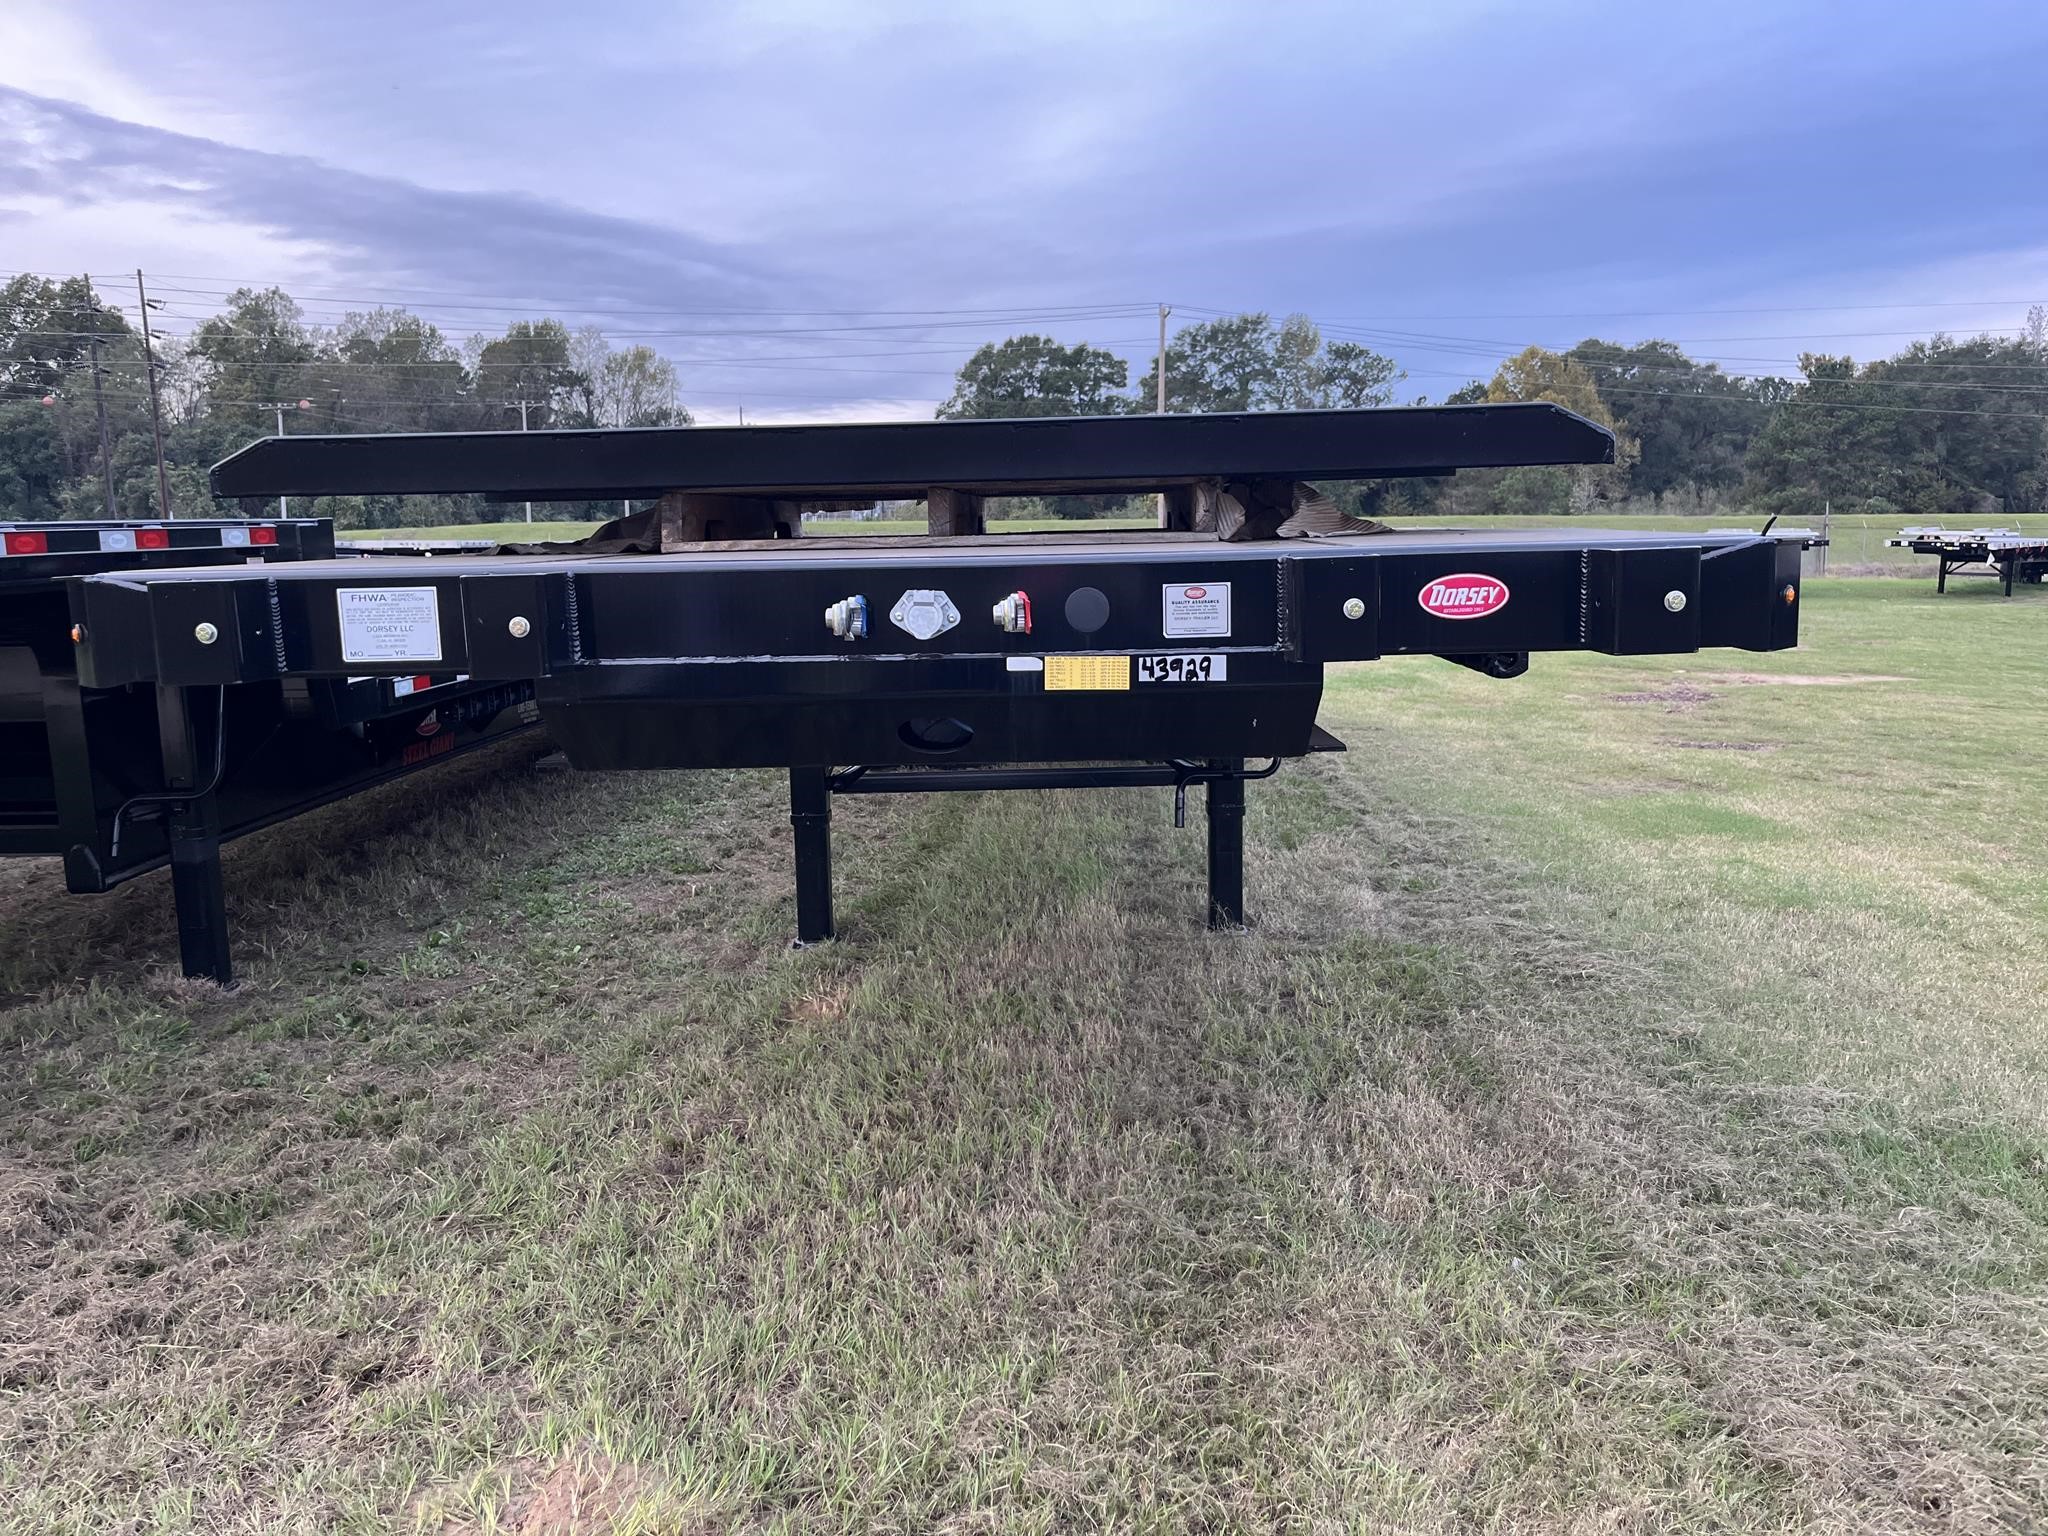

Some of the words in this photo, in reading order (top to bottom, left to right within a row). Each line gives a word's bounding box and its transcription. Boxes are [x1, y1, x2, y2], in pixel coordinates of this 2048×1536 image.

[351, 594, 387, 602] FHWA
[1428, 585, 1501, 606] DORSEY
[366, 625, 398, 633] DORSEY
[400, 624, 415, 632] LLC
[1141, 655, 1213, 682] 43929
